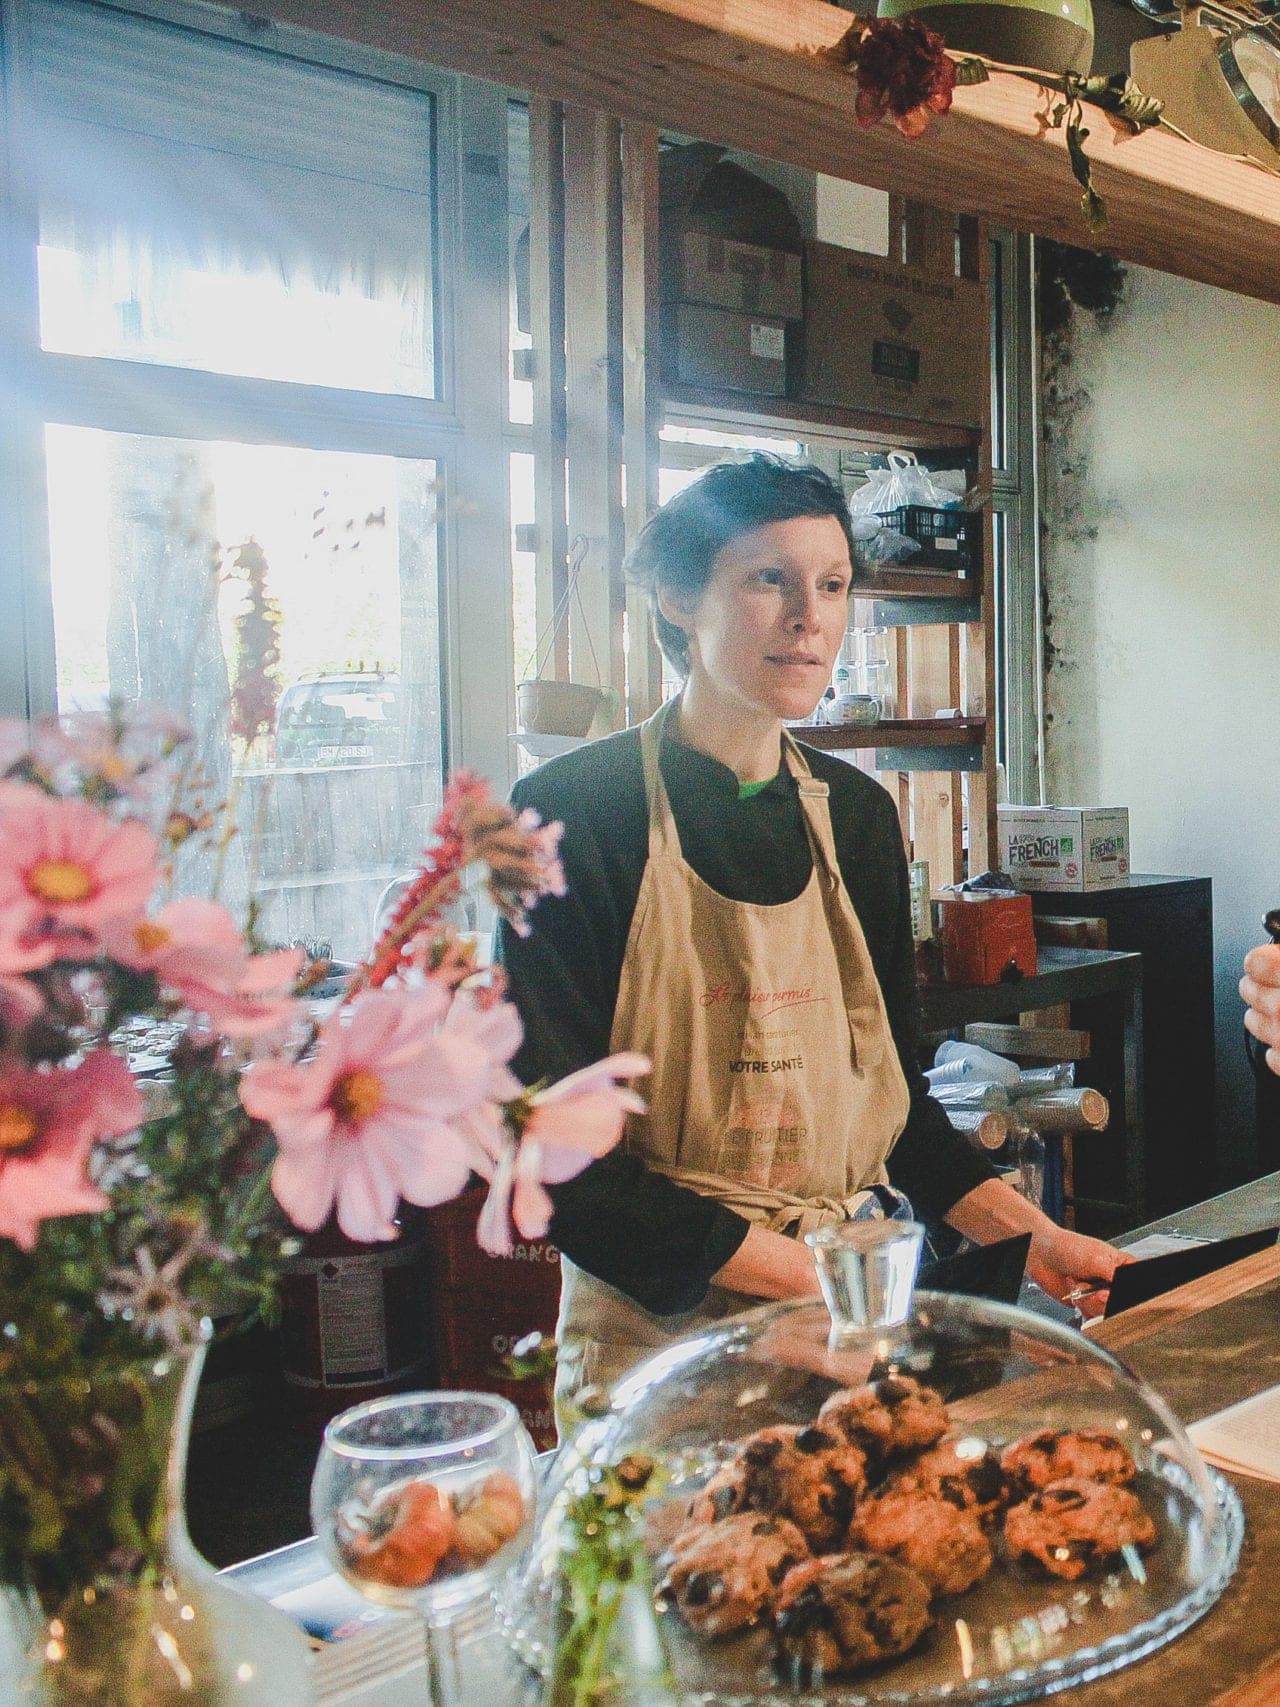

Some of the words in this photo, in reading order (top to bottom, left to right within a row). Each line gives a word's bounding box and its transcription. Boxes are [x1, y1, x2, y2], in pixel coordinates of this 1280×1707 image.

[1008, 835, 1018, 846] LA
[1008, 836, 1060, 866] FRENCH
[729, 1059, 769, 1074] VOTRE
[771, 1054, 804, 1071] SANTÉ
